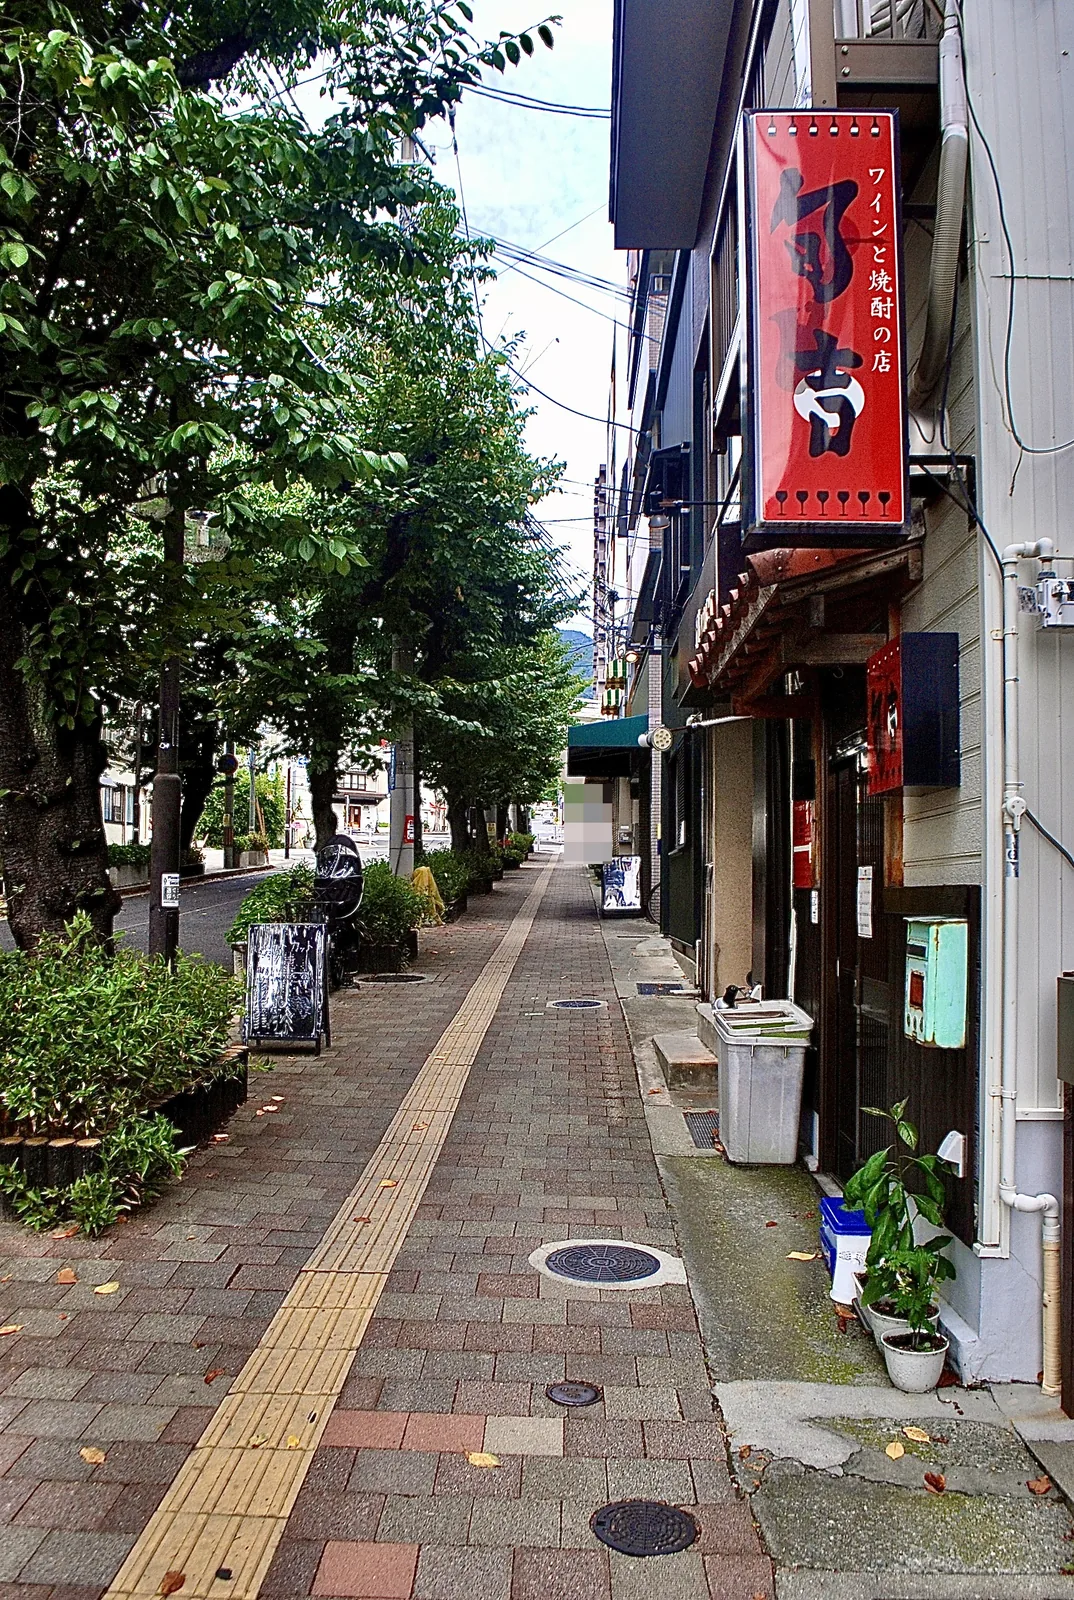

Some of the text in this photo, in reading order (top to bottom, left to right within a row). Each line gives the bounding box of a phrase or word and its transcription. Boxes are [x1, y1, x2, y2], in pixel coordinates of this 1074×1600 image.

[770, 167, 864, 458] 旬吉
[868, 167, 894, 373] ワインと焼酎の店
